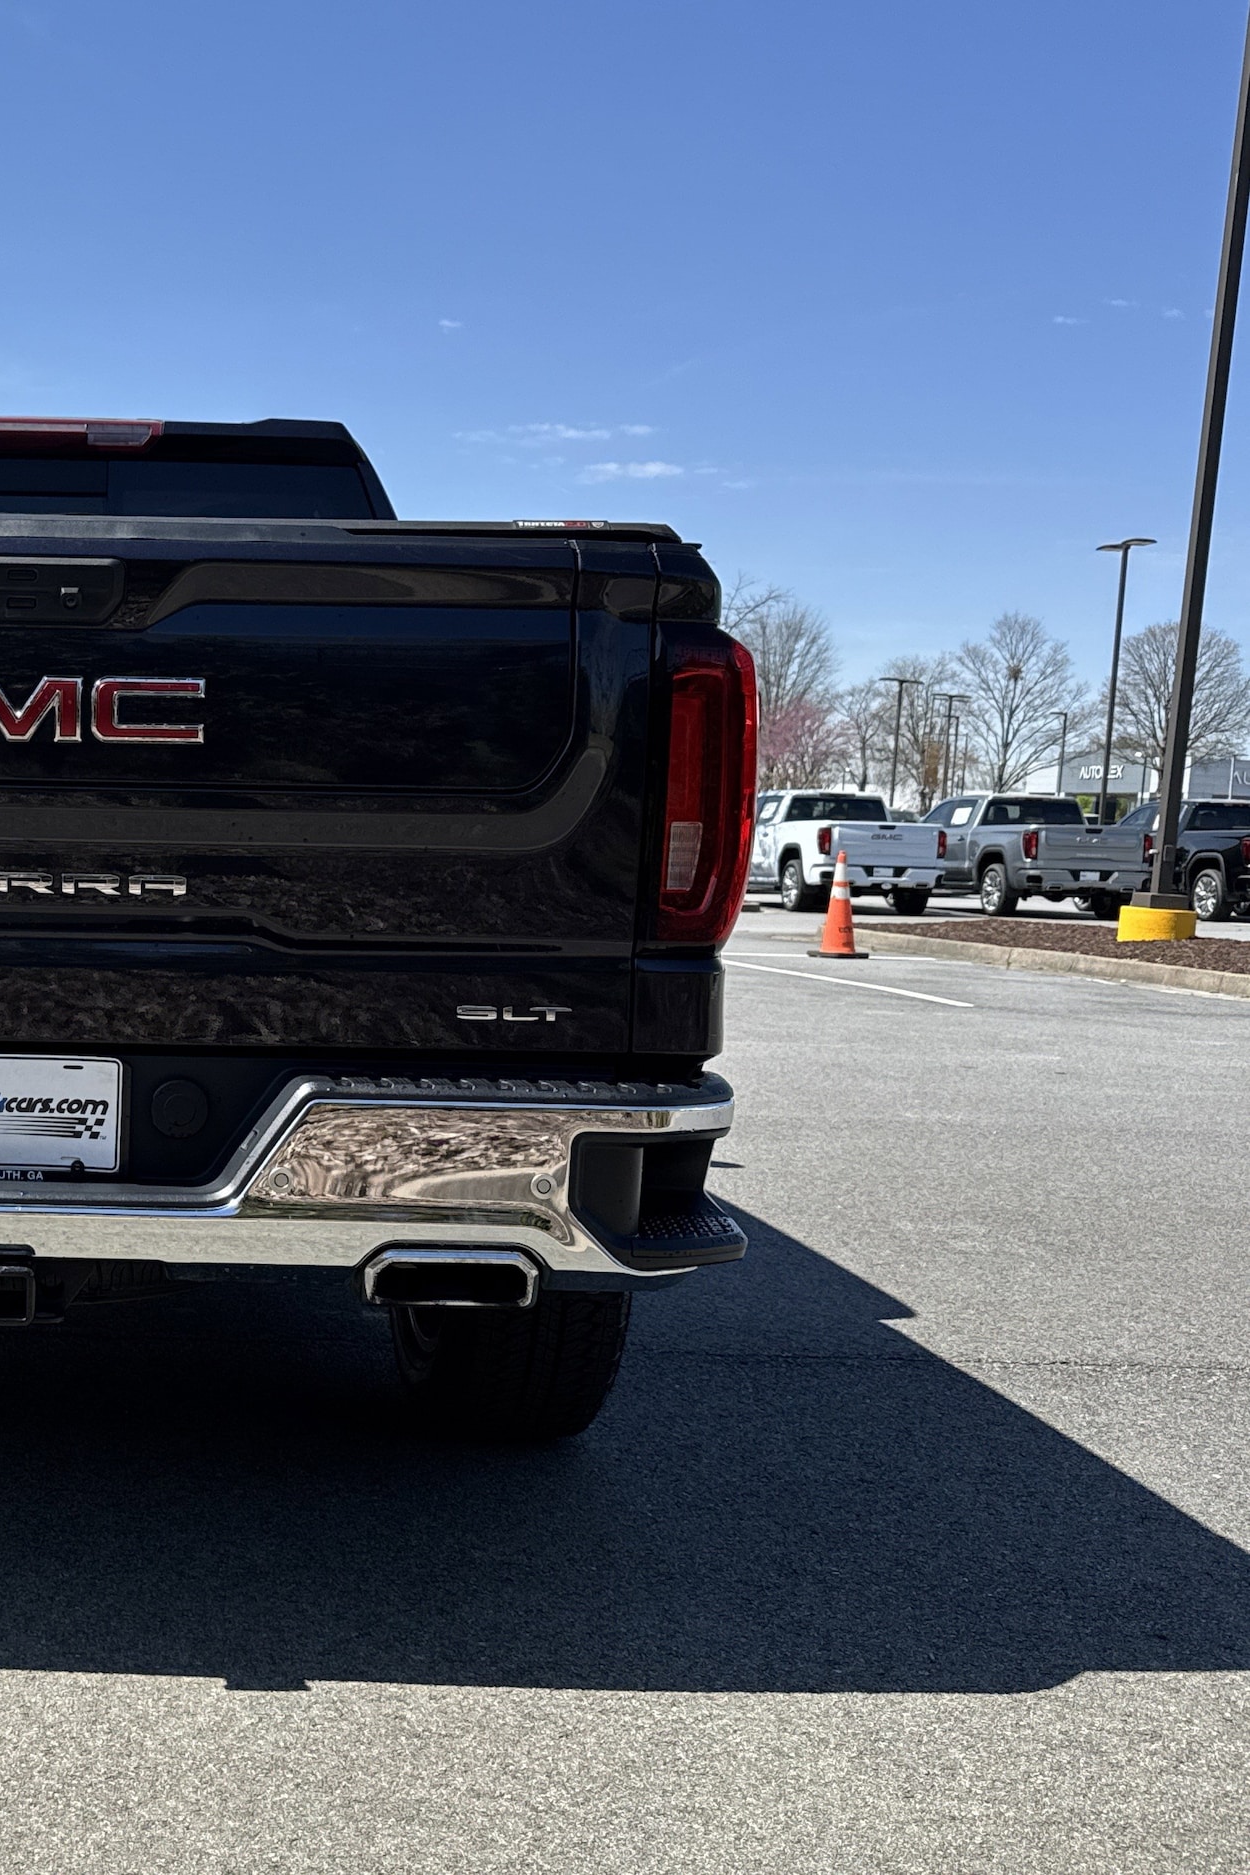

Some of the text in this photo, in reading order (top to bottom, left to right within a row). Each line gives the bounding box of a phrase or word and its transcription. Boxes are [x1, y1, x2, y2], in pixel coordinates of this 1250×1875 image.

[1079, 765, 1124, 779] AUTOEX
[456, 1005, 573, 1021] SLT
[27, 1170, 44, 1181] GA
